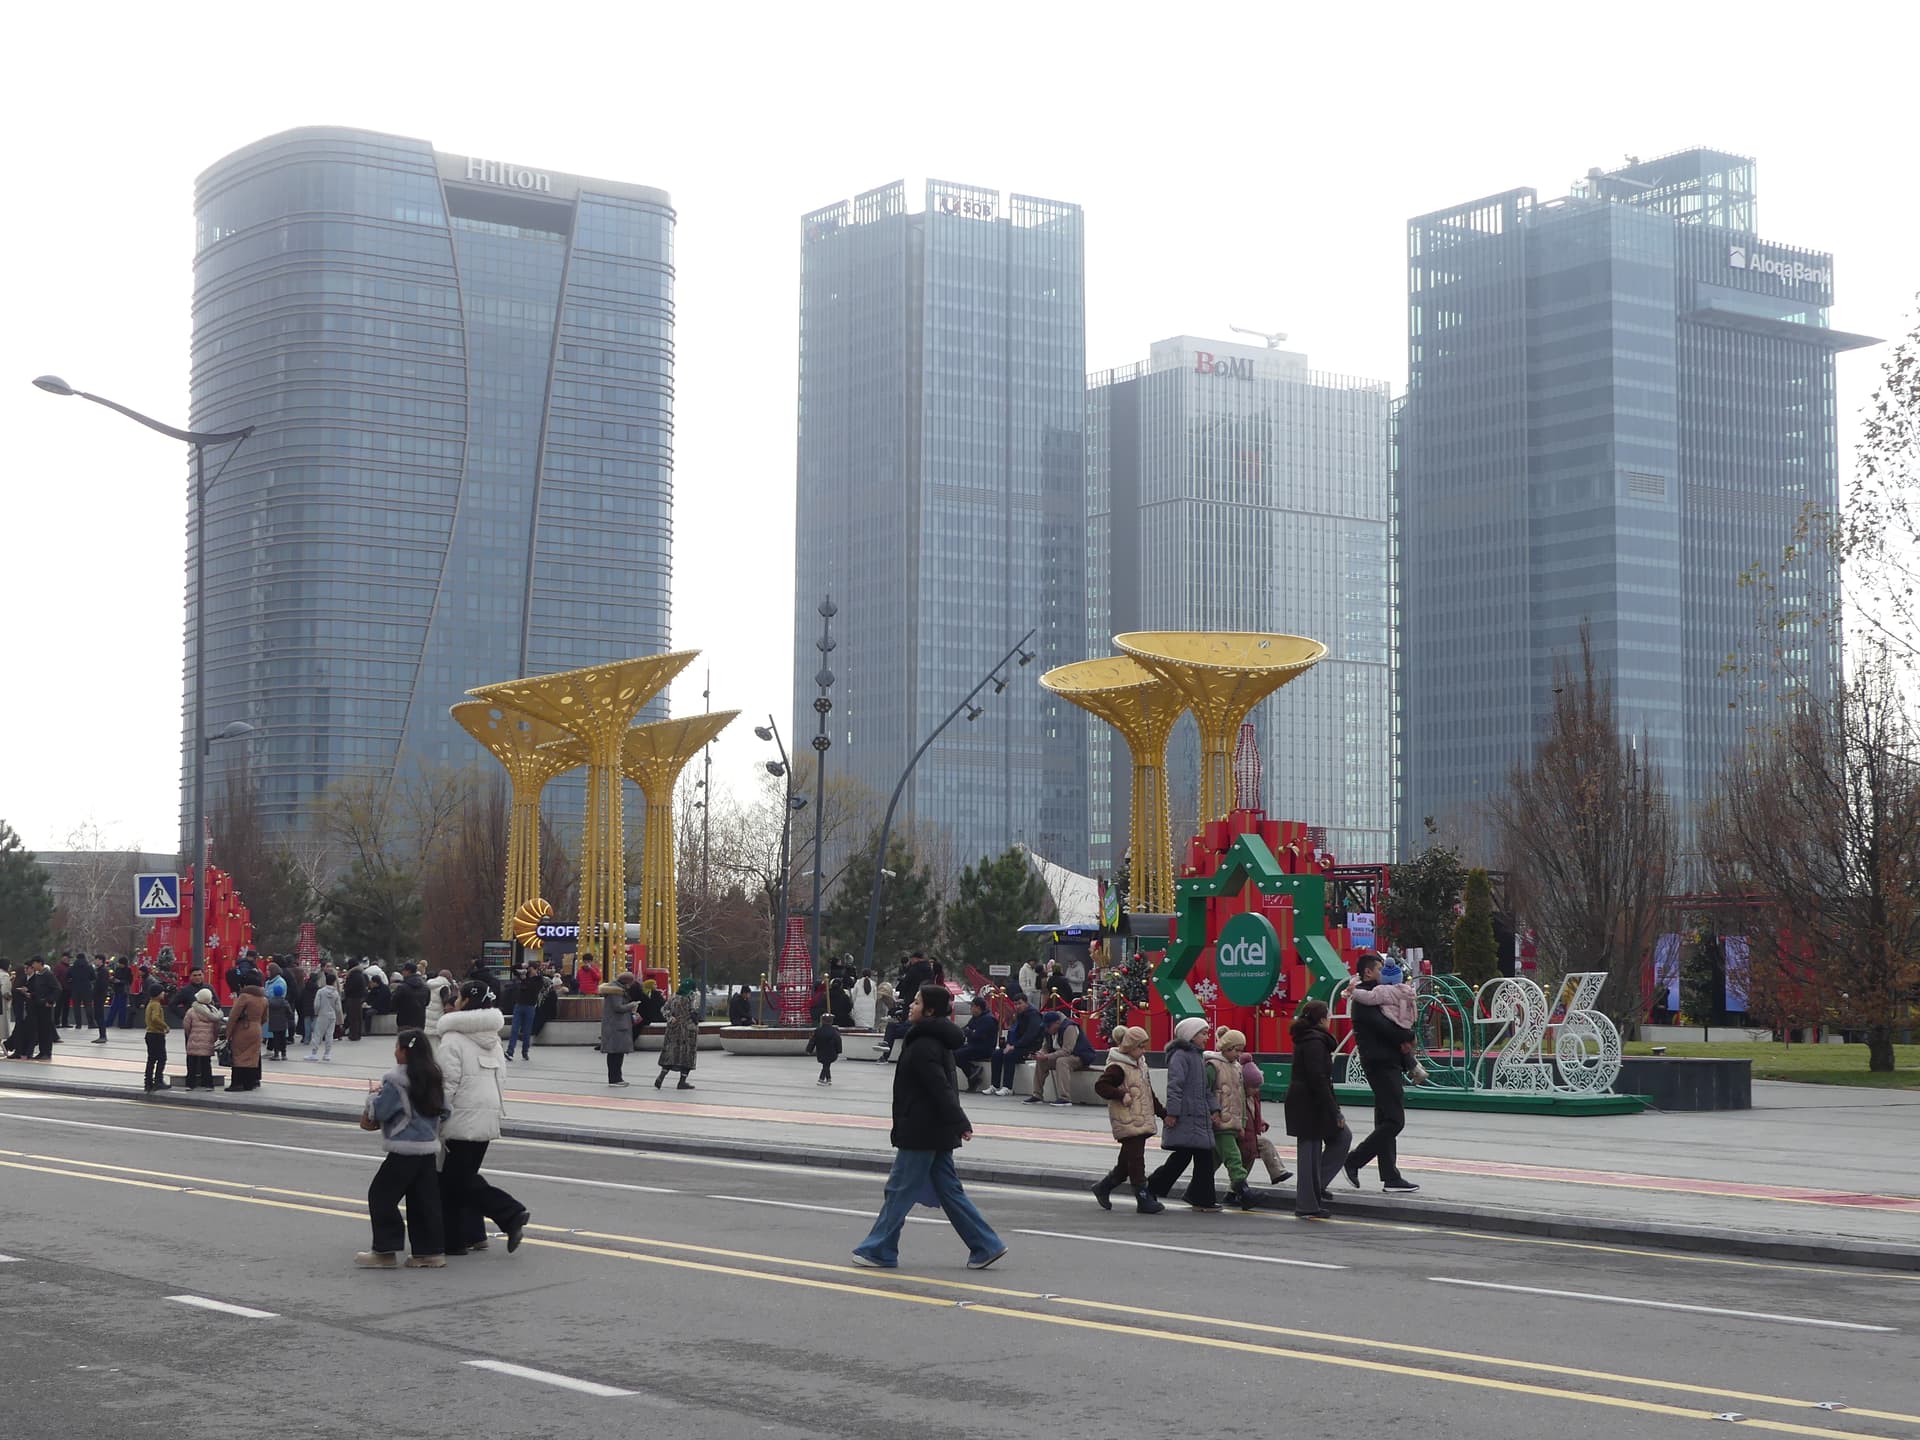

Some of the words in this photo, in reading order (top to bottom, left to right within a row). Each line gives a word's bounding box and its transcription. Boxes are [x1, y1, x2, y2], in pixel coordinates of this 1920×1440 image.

[464, 156, 550, 192] Hilton
[963, 201, 991, 217] SQB
[1750, 253, 1830, 284] AloqaBank
[1220, 936, 1266, 966] artel
